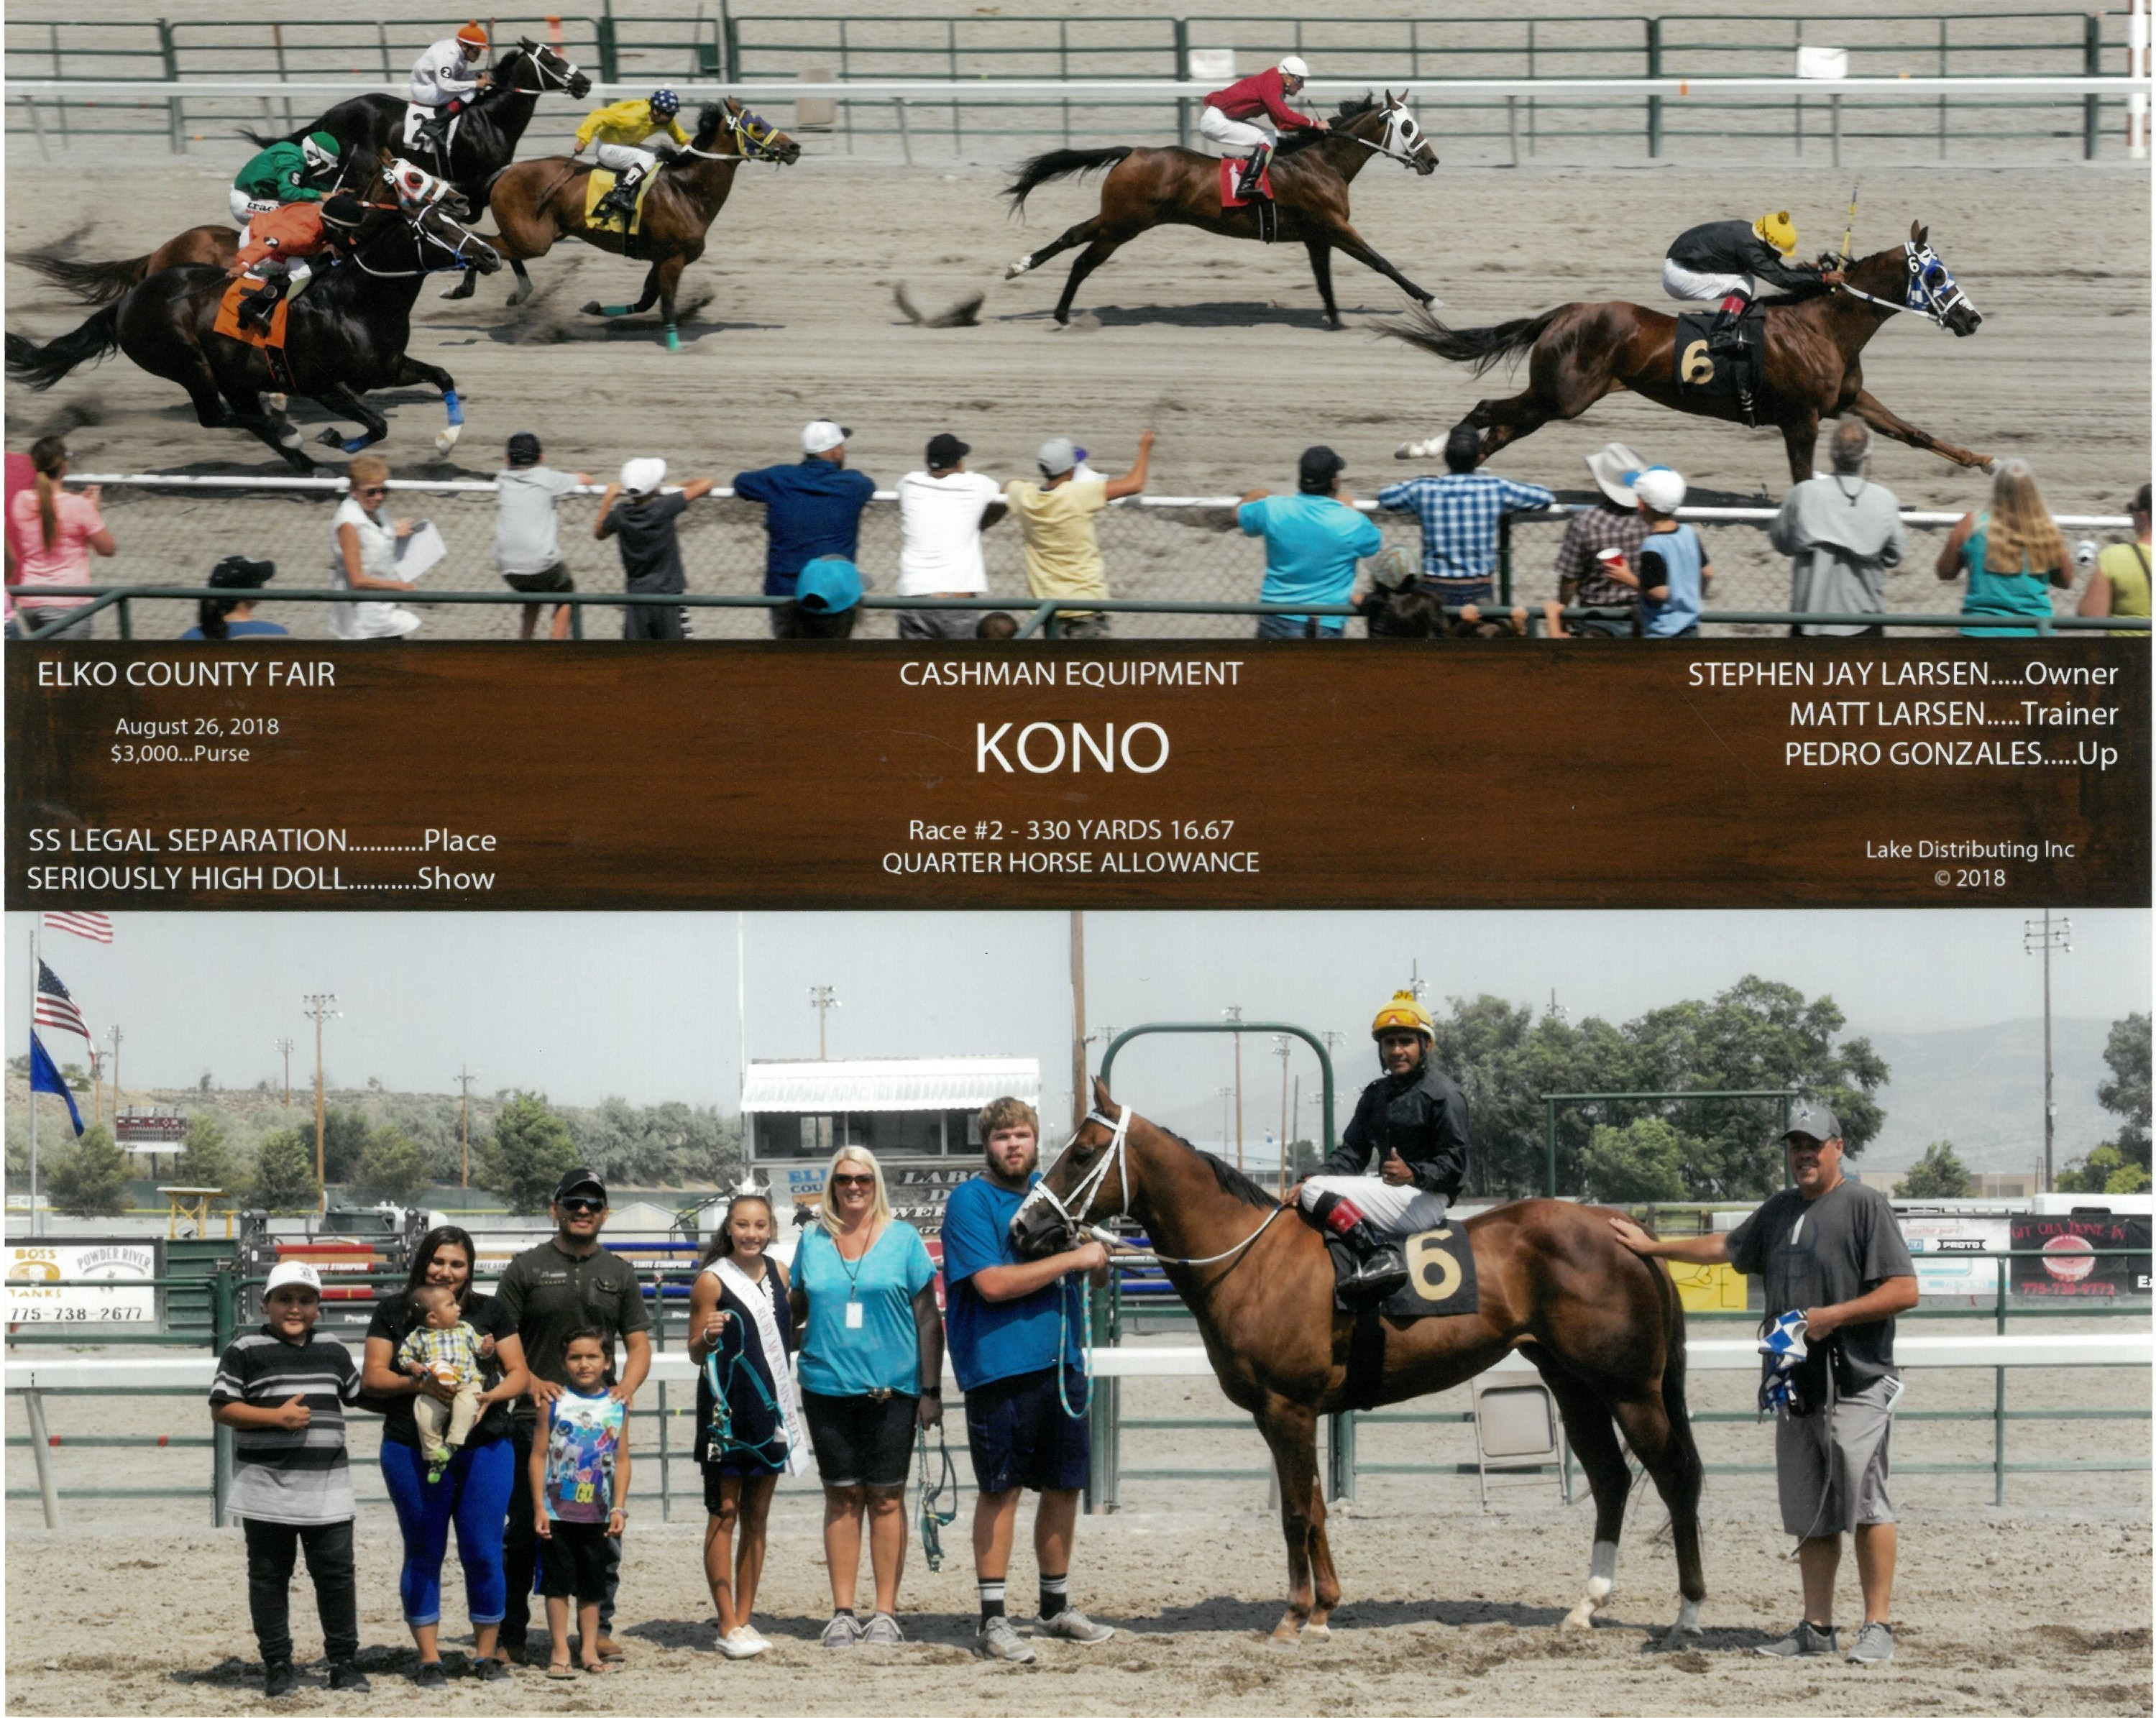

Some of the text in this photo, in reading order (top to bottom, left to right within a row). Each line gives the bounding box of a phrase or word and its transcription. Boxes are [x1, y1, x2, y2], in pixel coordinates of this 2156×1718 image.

[1907, 256, 1920, 273] 6
[1681, 339, 1715, 385] 6
[790, 1183, 823, 1193] COU
[14, 1248, 57, 1260] BOSS
[76, 1246, 152, 1270] POWDER RIVER
[1405, 1228, 1462, 1300] 6
[9, 1288, 63, 1298] TANKS
[11, 1306, 142, 1321] 775-738-2677
